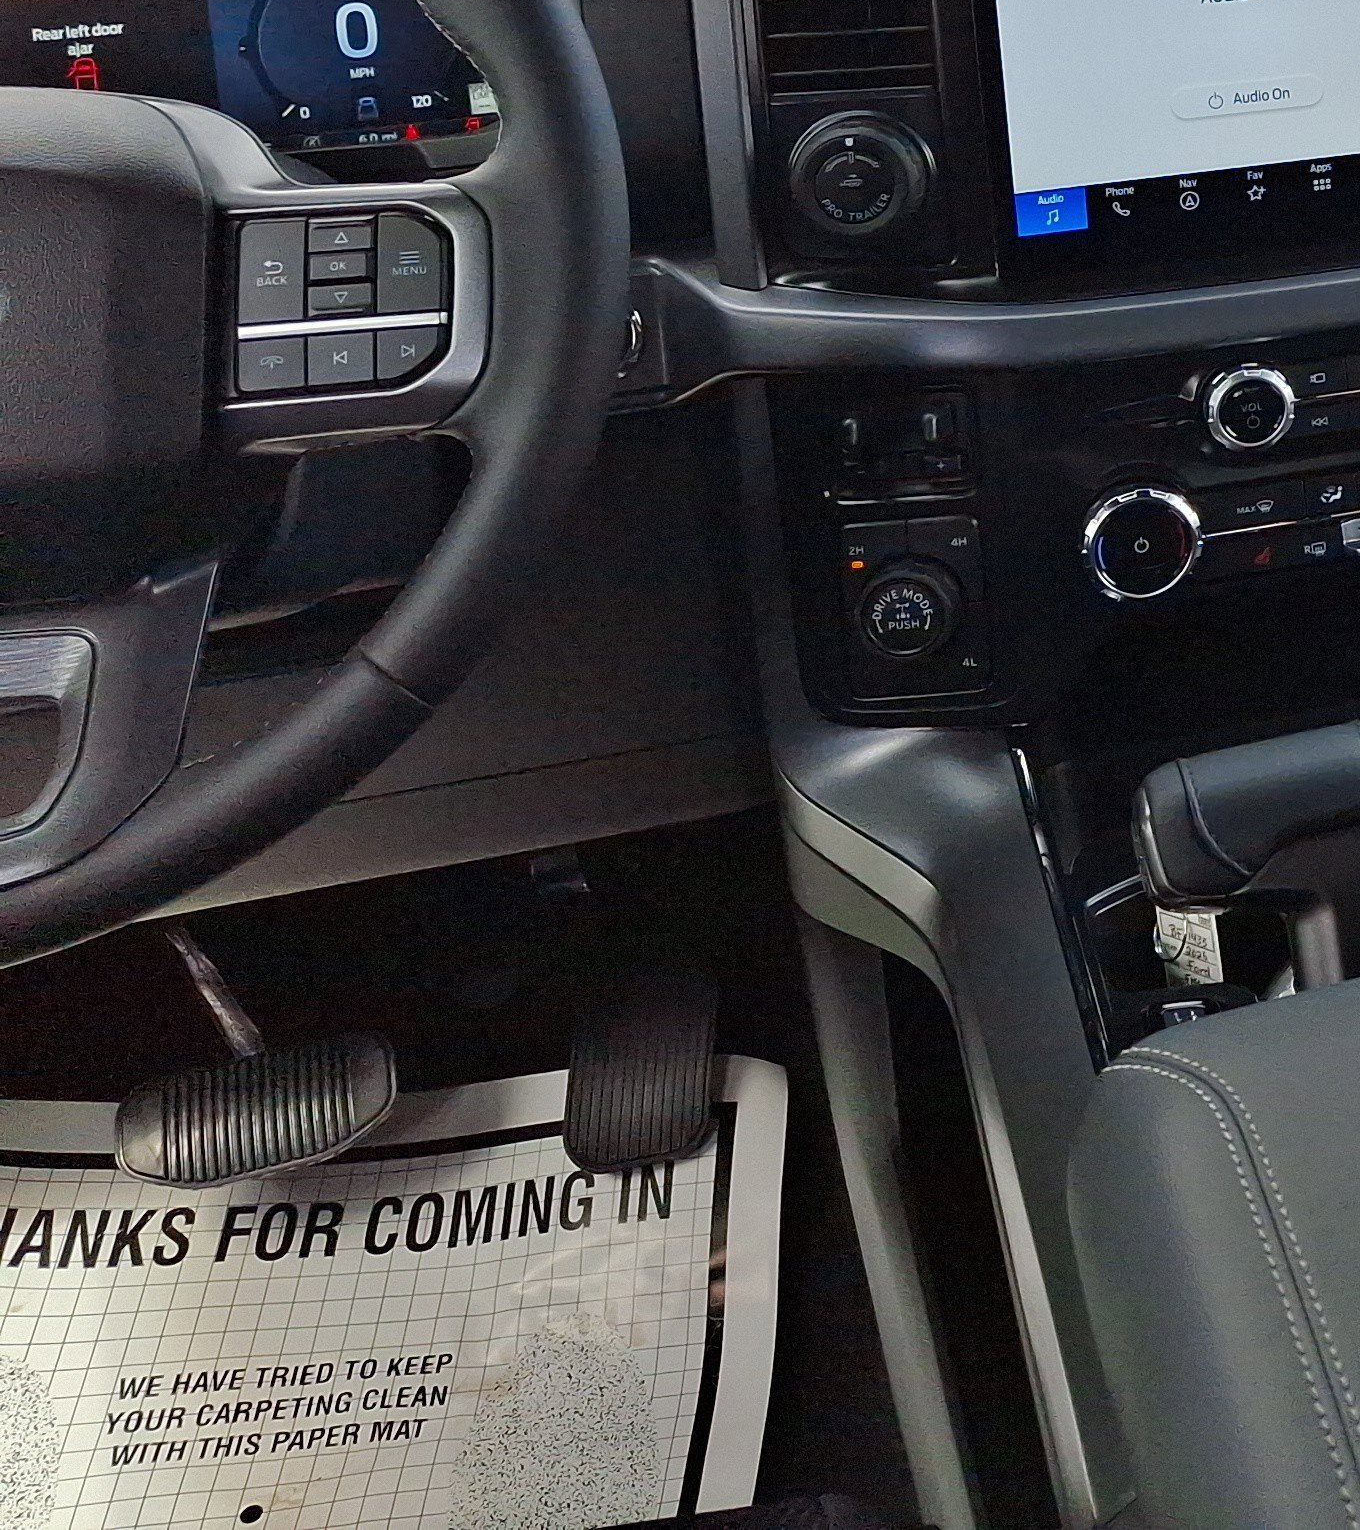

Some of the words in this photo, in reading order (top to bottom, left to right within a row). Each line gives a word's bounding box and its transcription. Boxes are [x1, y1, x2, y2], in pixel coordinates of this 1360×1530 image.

[32, 27, 64, 42] Rear
[66, 24, 90, 39] left
[92, 23, 124, 37] door
[336, 2, 378, 58] 0
[67, 43, 94, 57] ajar
[350, 67, 374, 79] MPH
[411, 95, 432, 108] 120
[1234, 91, 1269, 104] Audio
[1272, 88, 1290, 100] On
[300, 107, 310, 119] 0
[1310, 163, 1332, 174] Apps
[1247, 170, 1263, 181] Fav
[1179, 178, 1197, 188] Nav
[1106, 185, 1135, 197] Phone
[1038, 195, 1064, 205] Audio
[821, 198, 843, 219] PRO
[848, 193, 891, 222] TRAILER
[330, 262, 346, 271] OK
[392, 266, 426, 276] MENU
[257, 276, 287, 287] BACK
[1241, 402, 1262, 412] VOL
[1236, 505, 1256, 515] MAX
[951, 537, 967, 546] 4H
[850, 546, 864, 555] 2H
[872, 590, 899, 620] DRIVE
[903, 588, 933, 616] MODE
[888, 620, 919, 630] PUSH
[962, 658, 977, 667] 4L
[214, 1201, 344, 1262] FOR
[364, 1169, 595, 1255] COMING
[617, 1160, 675, 1224] IN
[119, 1375, 164, 1400] WE
[171, 1369, 246, 1396] HAVE
[256, 1362, 334, 1388] TRIED
[346, 1359, 378, 1380] TO
[387, 1353, 453, 1377] KEEP
[107, 1407, 186, 1435] YOUR
[196, 1391, 353, 1427] CARPETING
[363, 1386, 448, 1410] CLEAN
[111, 1440, 188, 1467] WITH
[199, 1433, 261, 1459] THIS
[271, 1423, 360, 1453] PAPER
[370, 1418, 428, 1443] MAT
